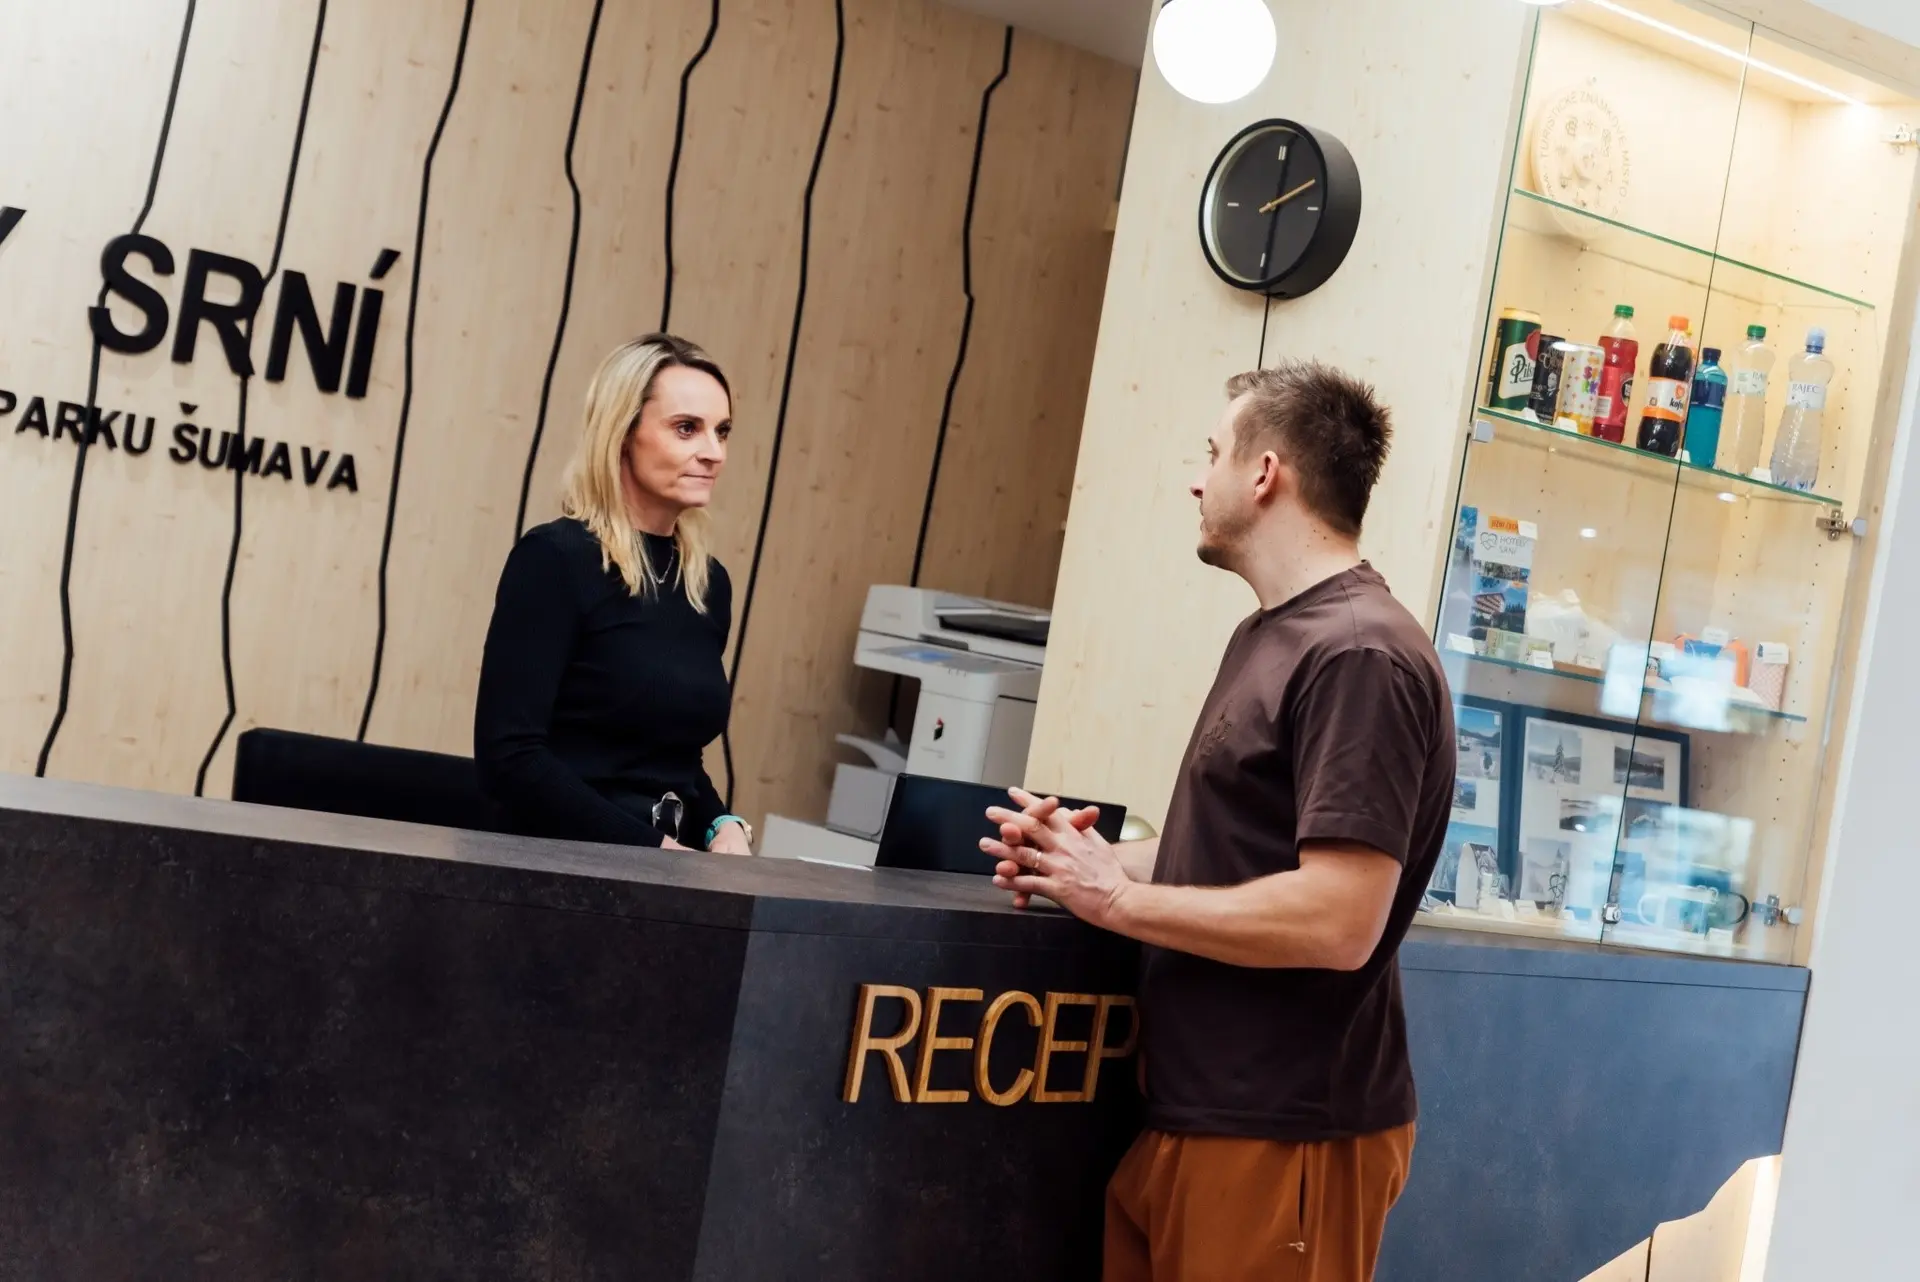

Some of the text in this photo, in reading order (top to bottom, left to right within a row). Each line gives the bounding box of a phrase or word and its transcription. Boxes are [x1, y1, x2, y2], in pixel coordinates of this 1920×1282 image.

[88, 233, 401, 399] SRNÍ
[1791, 383, 1820, 394] RAJEC
[168, 402, 359, 494] ŠUMAVA
[842, 983, 1141, 1106] RECEP
